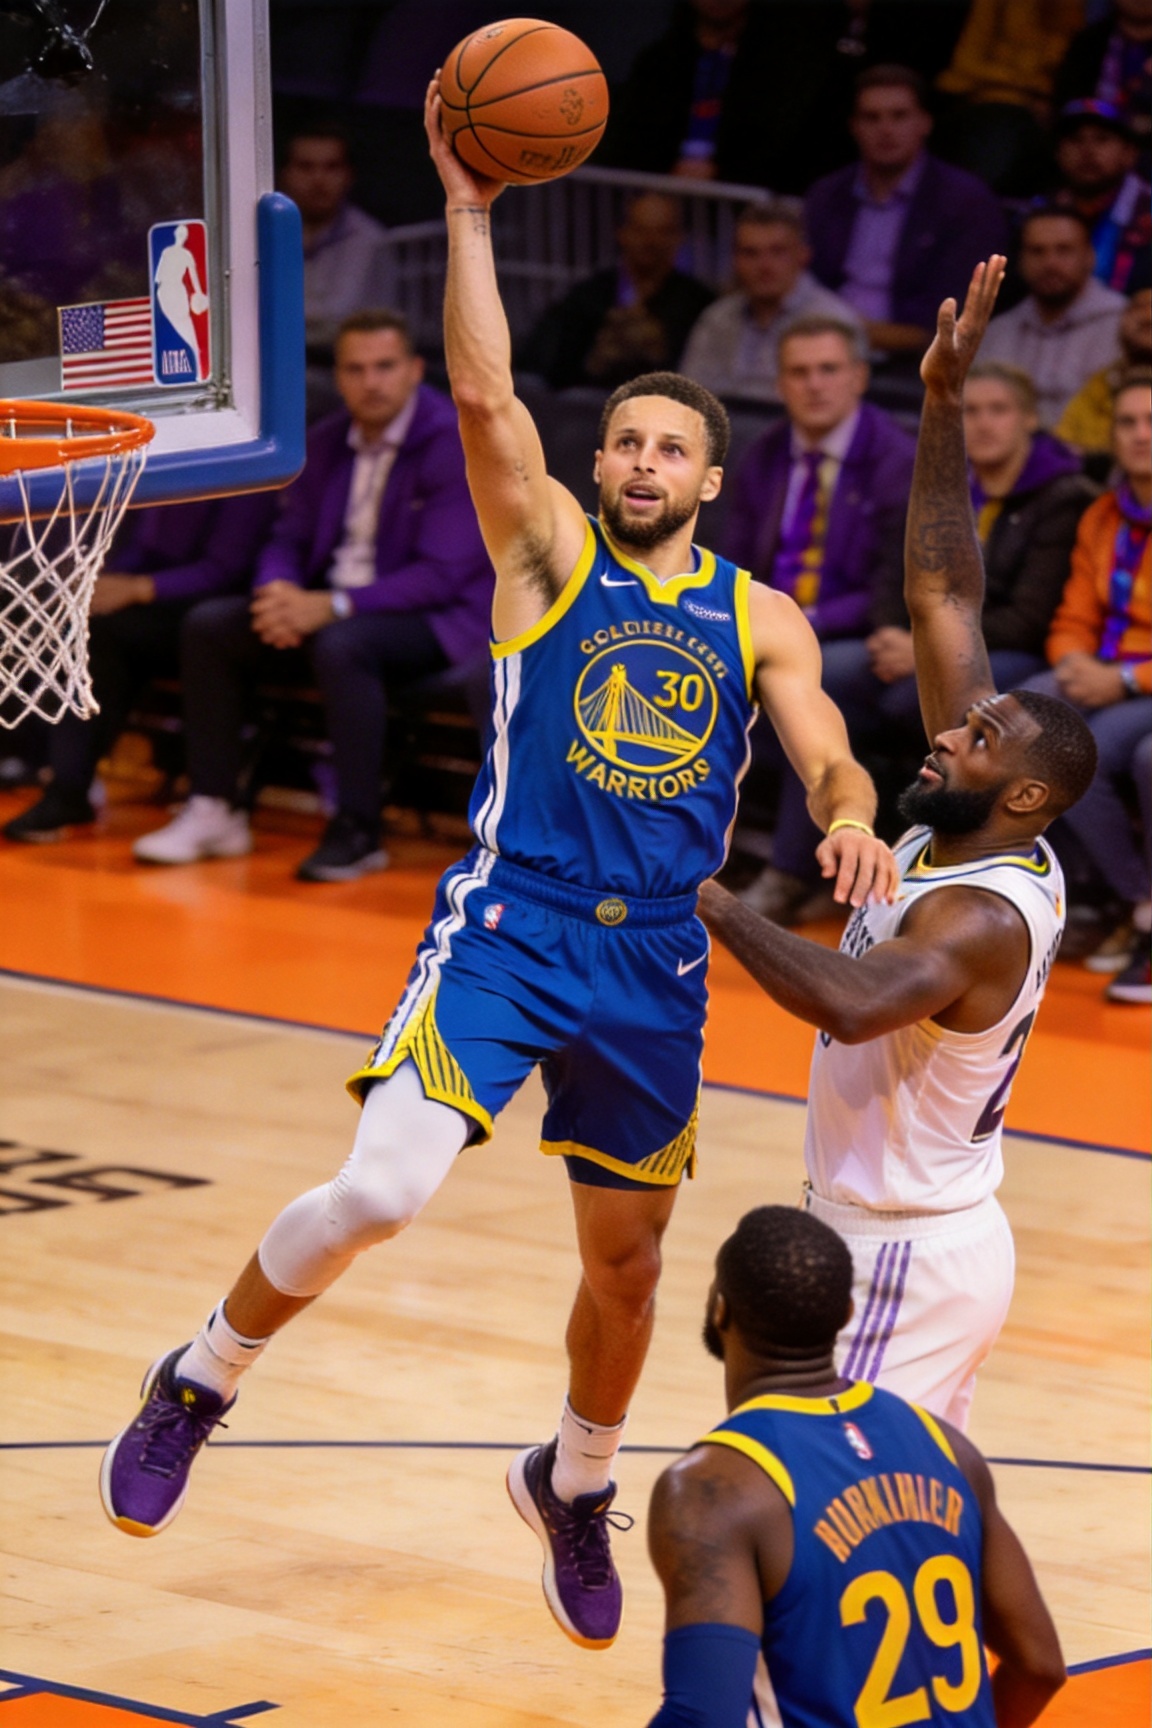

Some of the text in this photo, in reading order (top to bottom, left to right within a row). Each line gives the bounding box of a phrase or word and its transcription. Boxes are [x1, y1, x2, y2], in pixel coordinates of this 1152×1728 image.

[653, 669, 705, 712] 30
[565, 738, 711, 800] WARRIORS
[839, 1554, 982, 1728] 29
